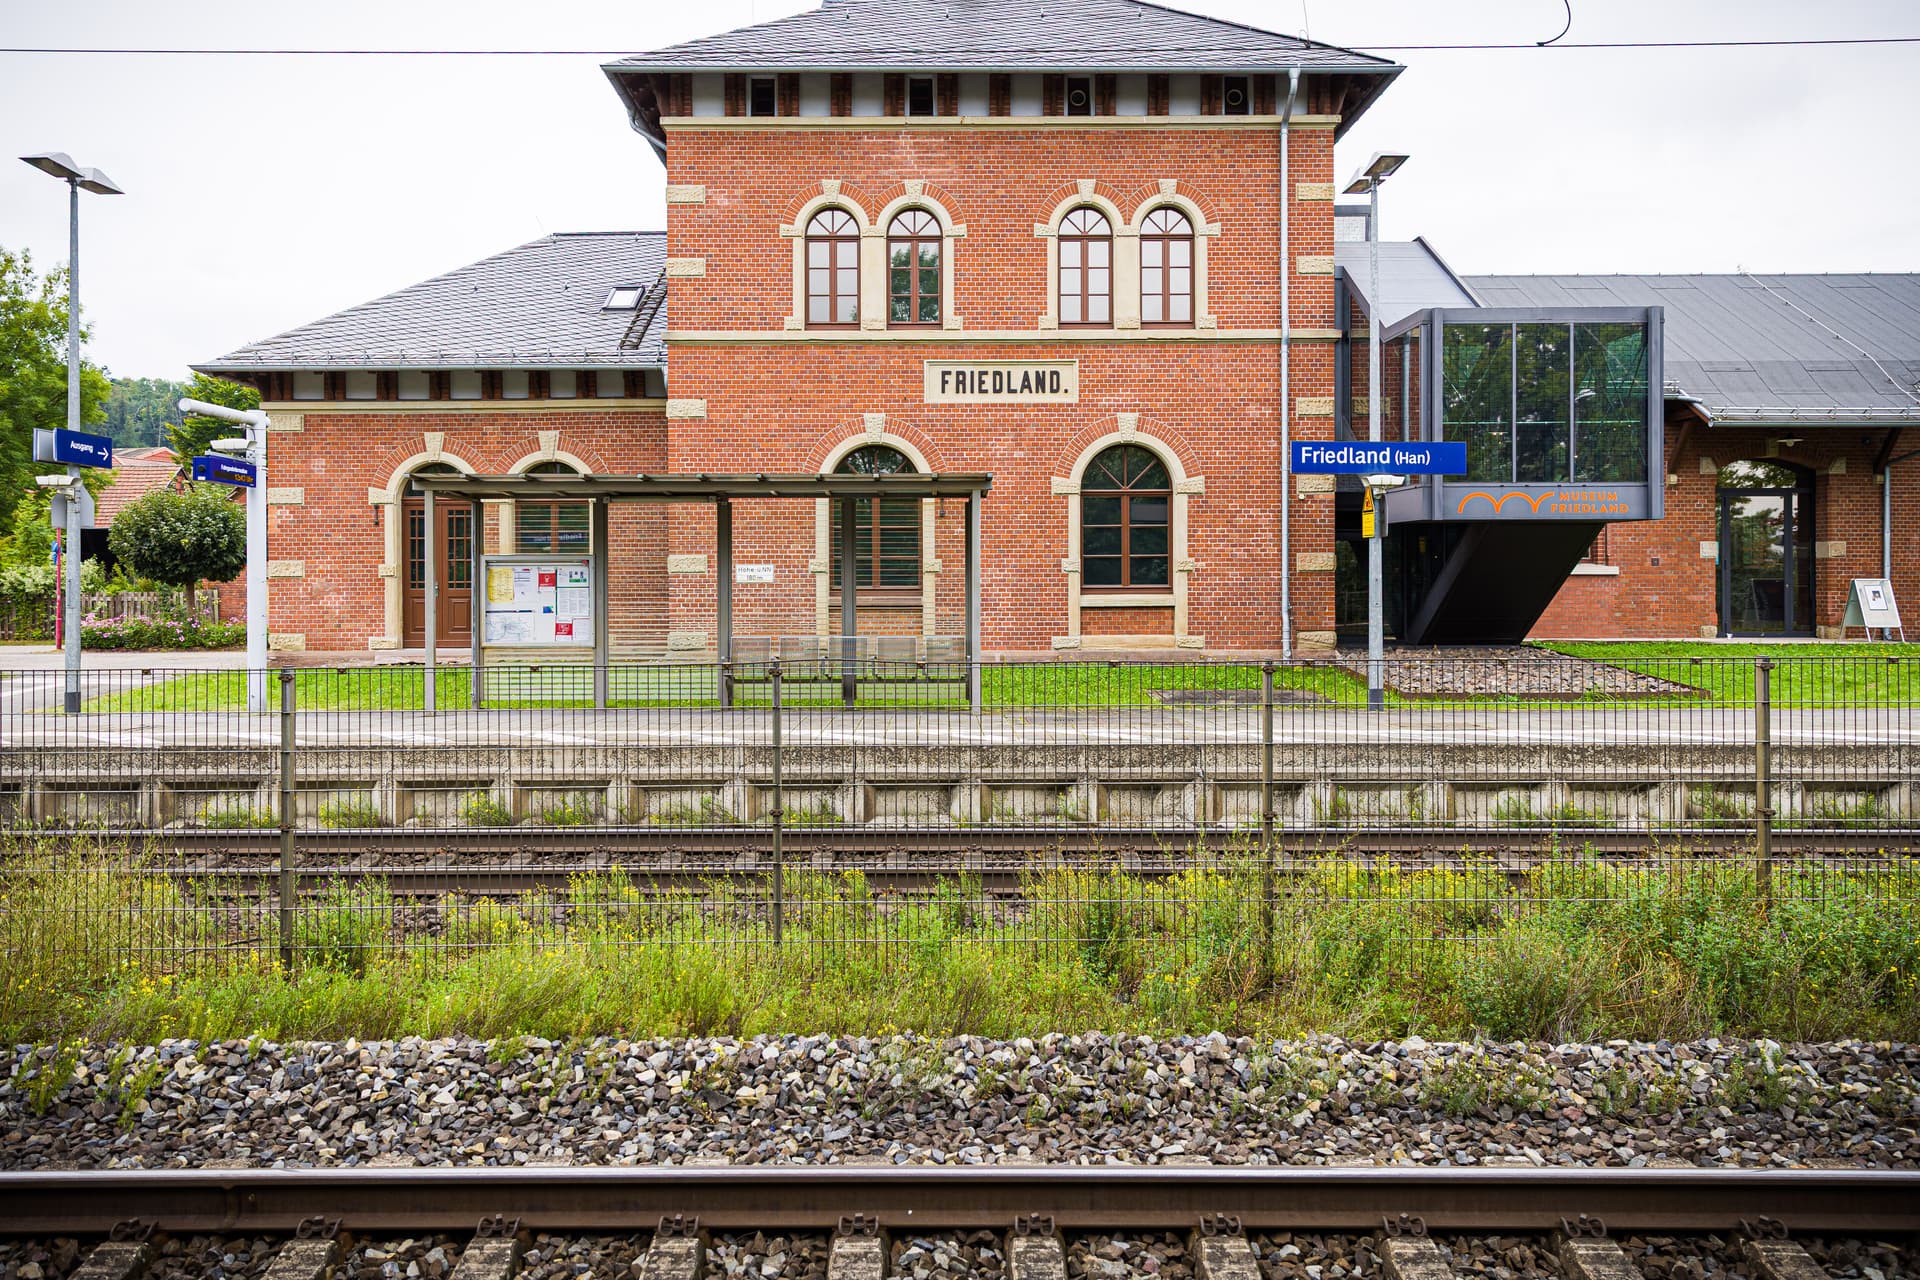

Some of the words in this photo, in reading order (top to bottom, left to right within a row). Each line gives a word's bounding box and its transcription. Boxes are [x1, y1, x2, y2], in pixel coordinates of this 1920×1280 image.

[941, 370, 1069, 394] FRIEDLAND.
[70, 440, 94, 454] Ausgang
[1301, 446, 1390, 464] Friedland
[1394, 449, 1431, 466] (Han)
[1559, 491, 1618, 501] MUSEUM
[1551, 503, 1629, 513] FRIEDLAND
